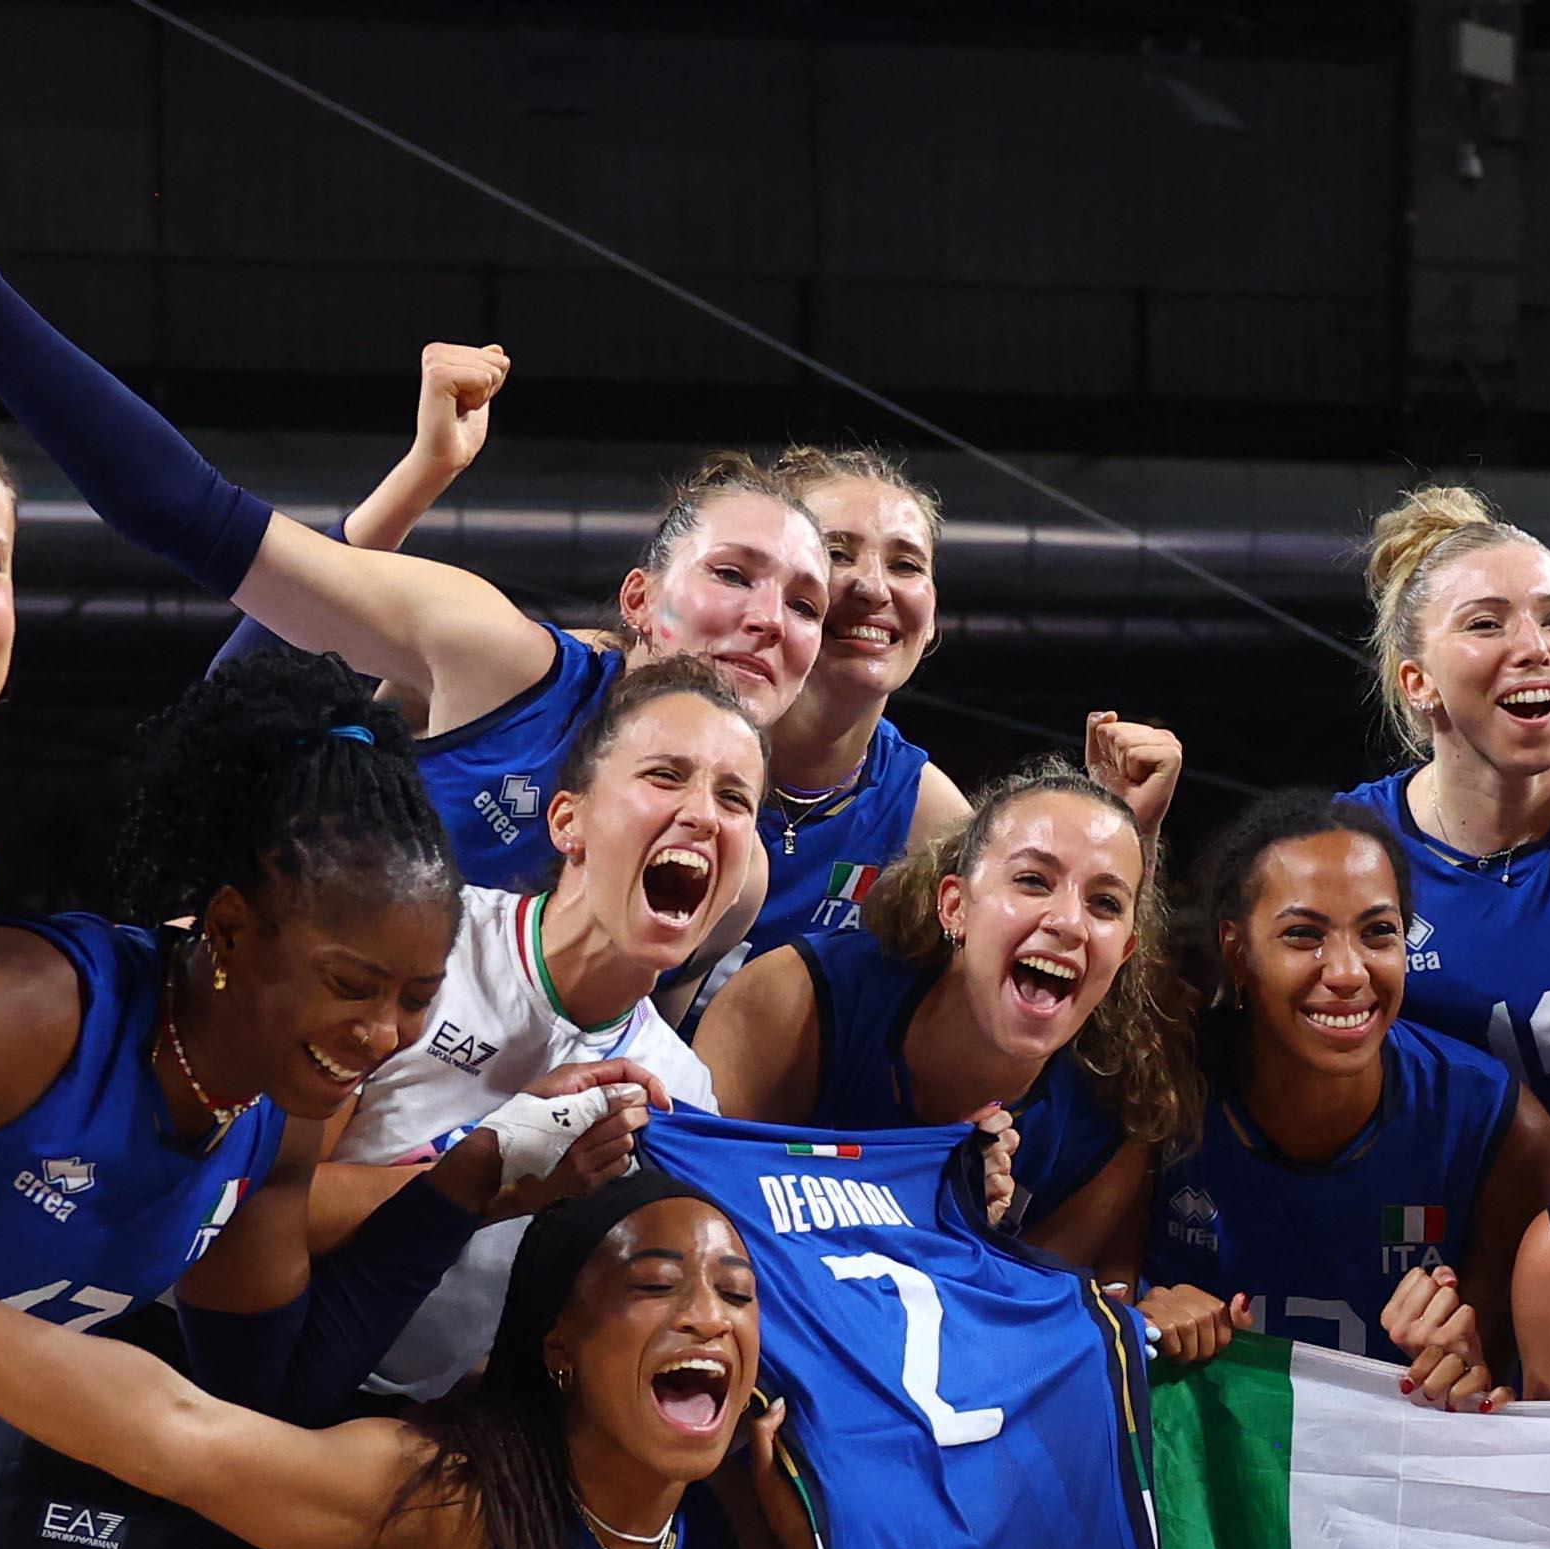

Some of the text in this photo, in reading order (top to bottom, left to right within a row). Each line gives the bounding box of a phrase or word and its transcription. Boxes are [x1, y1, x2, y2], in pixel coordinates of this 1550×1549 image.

[473, 790, 520, 845] errea
[811, 899, 861, 930] ITA
[1406, 951, 1441, 972] rea
[431, 1020, 499, 1066] EA7
[13, 1170, 78, 1223] errea
[758, 1175, 915, 1234] DEGRADI
[185, 1228, 221, 1262] IT
[1168, 1220, 1219, 1252] errea
[1382, 1245, 1444, 1274] ITA
[820, 1252, 1004, 1447] 2
[43, 1502, 125, 1539] EA7
